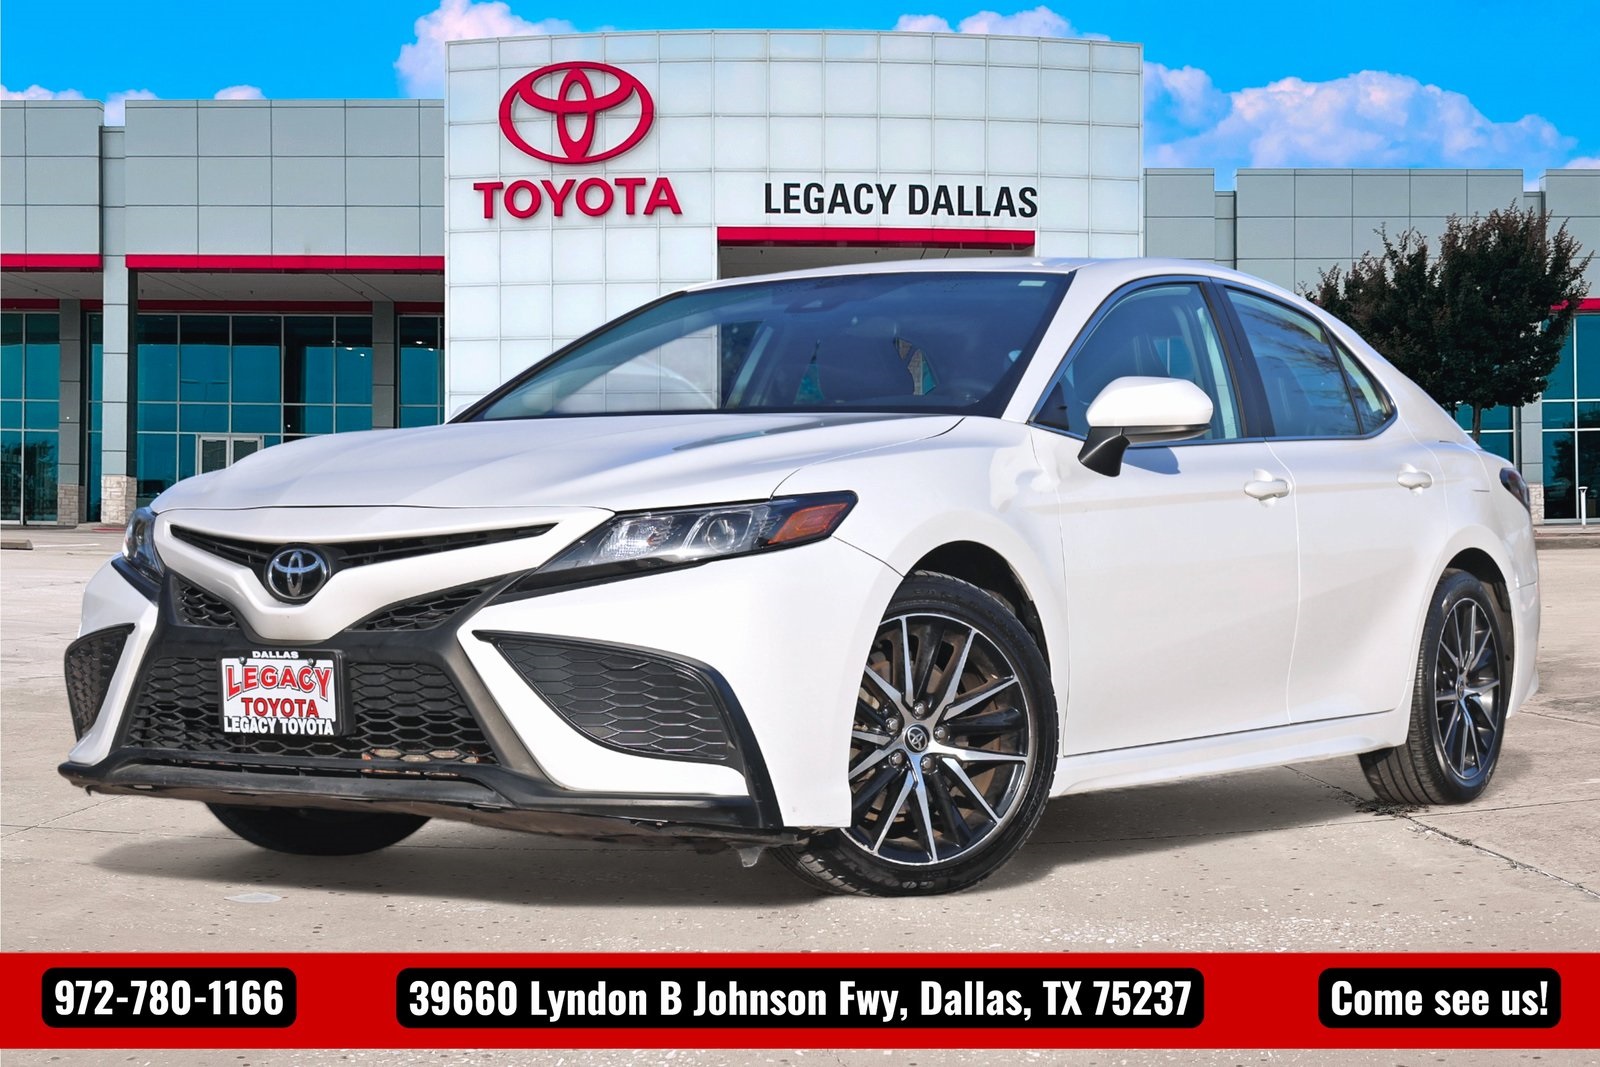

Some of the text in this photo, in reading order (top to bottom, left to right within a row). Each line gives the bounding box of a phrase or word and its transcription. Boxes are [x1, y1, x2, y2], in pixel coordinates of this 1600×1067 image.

[473, 177, 682, 219] TOYOTA
[764, 182, 1038, 218] LEGACY DALLAS
[252, 650, 299, 659] DALLAS
[226, 665, 332, 702] LEGACY
[241, 697, 319, 718] TOYOTA
[224, 716, 334, 735] LEGACY TOYOTA
